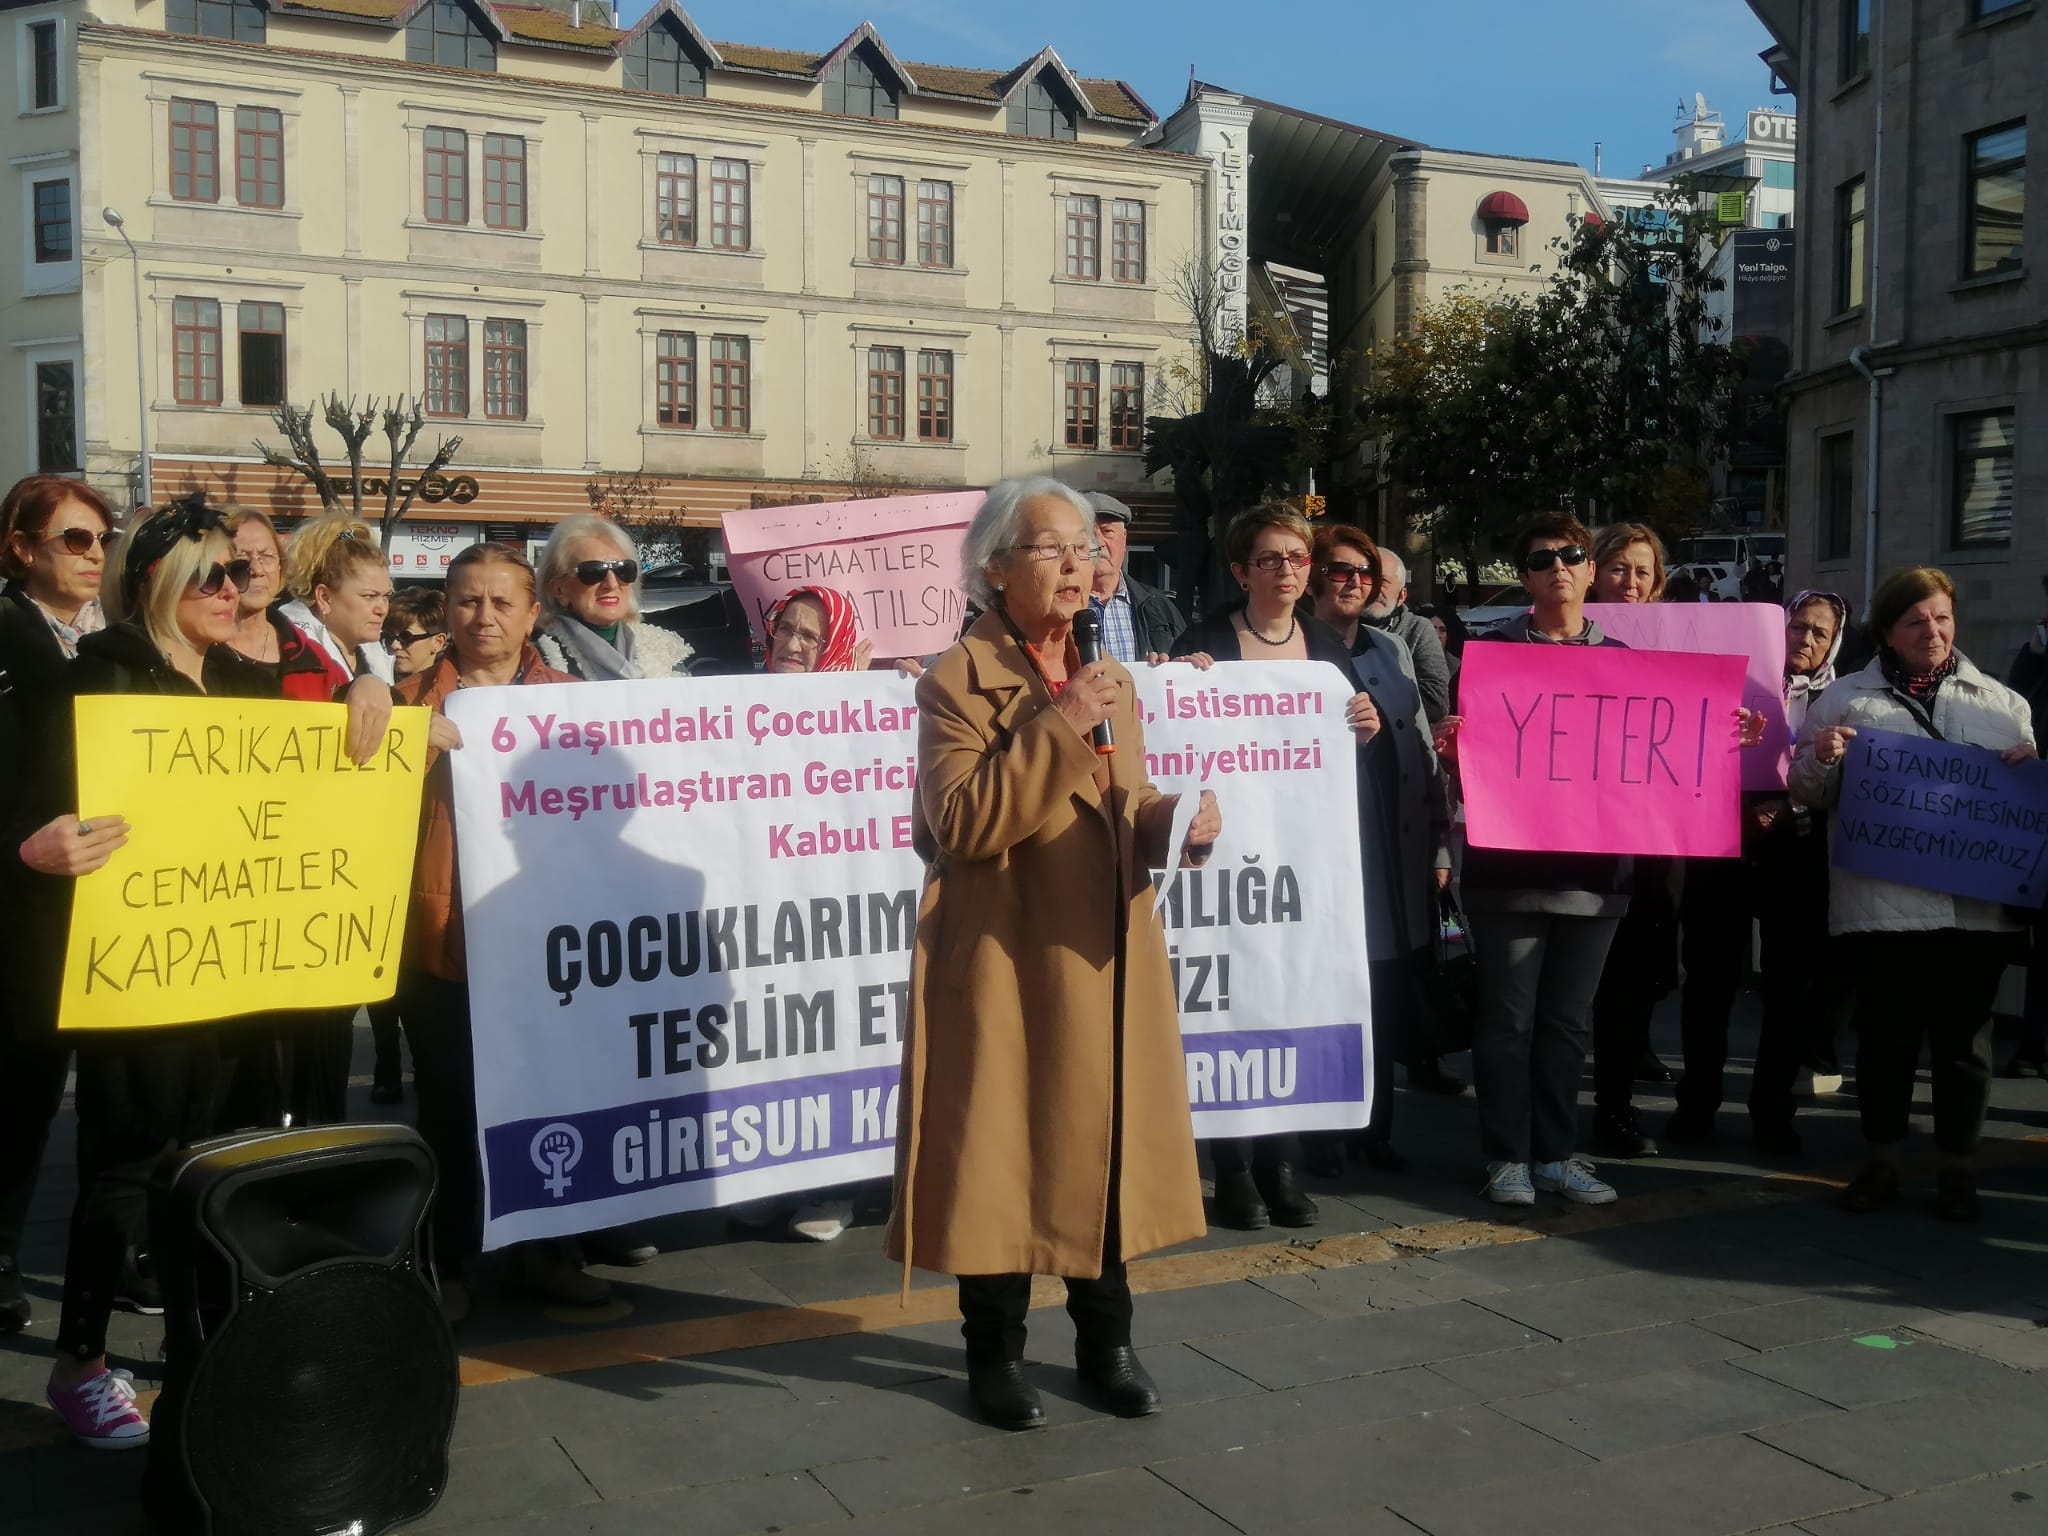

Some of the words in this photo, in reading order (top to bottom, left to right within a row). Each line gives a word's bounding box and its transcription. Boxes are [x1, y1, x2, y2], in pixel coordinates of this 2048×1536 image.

[1754, 115, 1796, 139] OTE
[1738, 263, 1758, 272] Yeni
[1760, 262, 1788, 274] Taigo.
[316, 474, 479, 505] EKNOSA
[408, 525, 459, 535] TEKNO
[763, 543, 940, 582] CEMAATLER
[756, 585, 967, 642] KATILSIN!
[131, 713, 412, 775] TARİKATLR
[491, 716, 518, 753] 6
[528, 704, 735, 755] Yaşındaki
[746, 699, 917, 746] Çocuklar
[1165, 679, 1323, 720] İstismarı
[1501, 691, 1708, 798] YETER!
[500, 769, 792, 821] Meşrulaştıran
[804, 756, 916, 796] Gerici
[1865, 738, 1999, 792] İSTANBUL
[237, 800, 287, 841] VE
[1853, 778, 2048, 835] SÖZLEŞMESİNDE
[769, 818, 880, 859] Kabul
[1841, 818, 2048, 895] VAZGEÇMİYORUZ!
[122, 848, 358, 909] CEMAATLER
[86, 894, 397, 995] KAPATILSIN!
[546, 889, 917, 1006] ÇOCUKLARIM
[629, 983, 836, 1080] TESLİM
[612, 1092, 831, 1186] GİRESUN
[1185, 1046, 1297, 1104] RMU
